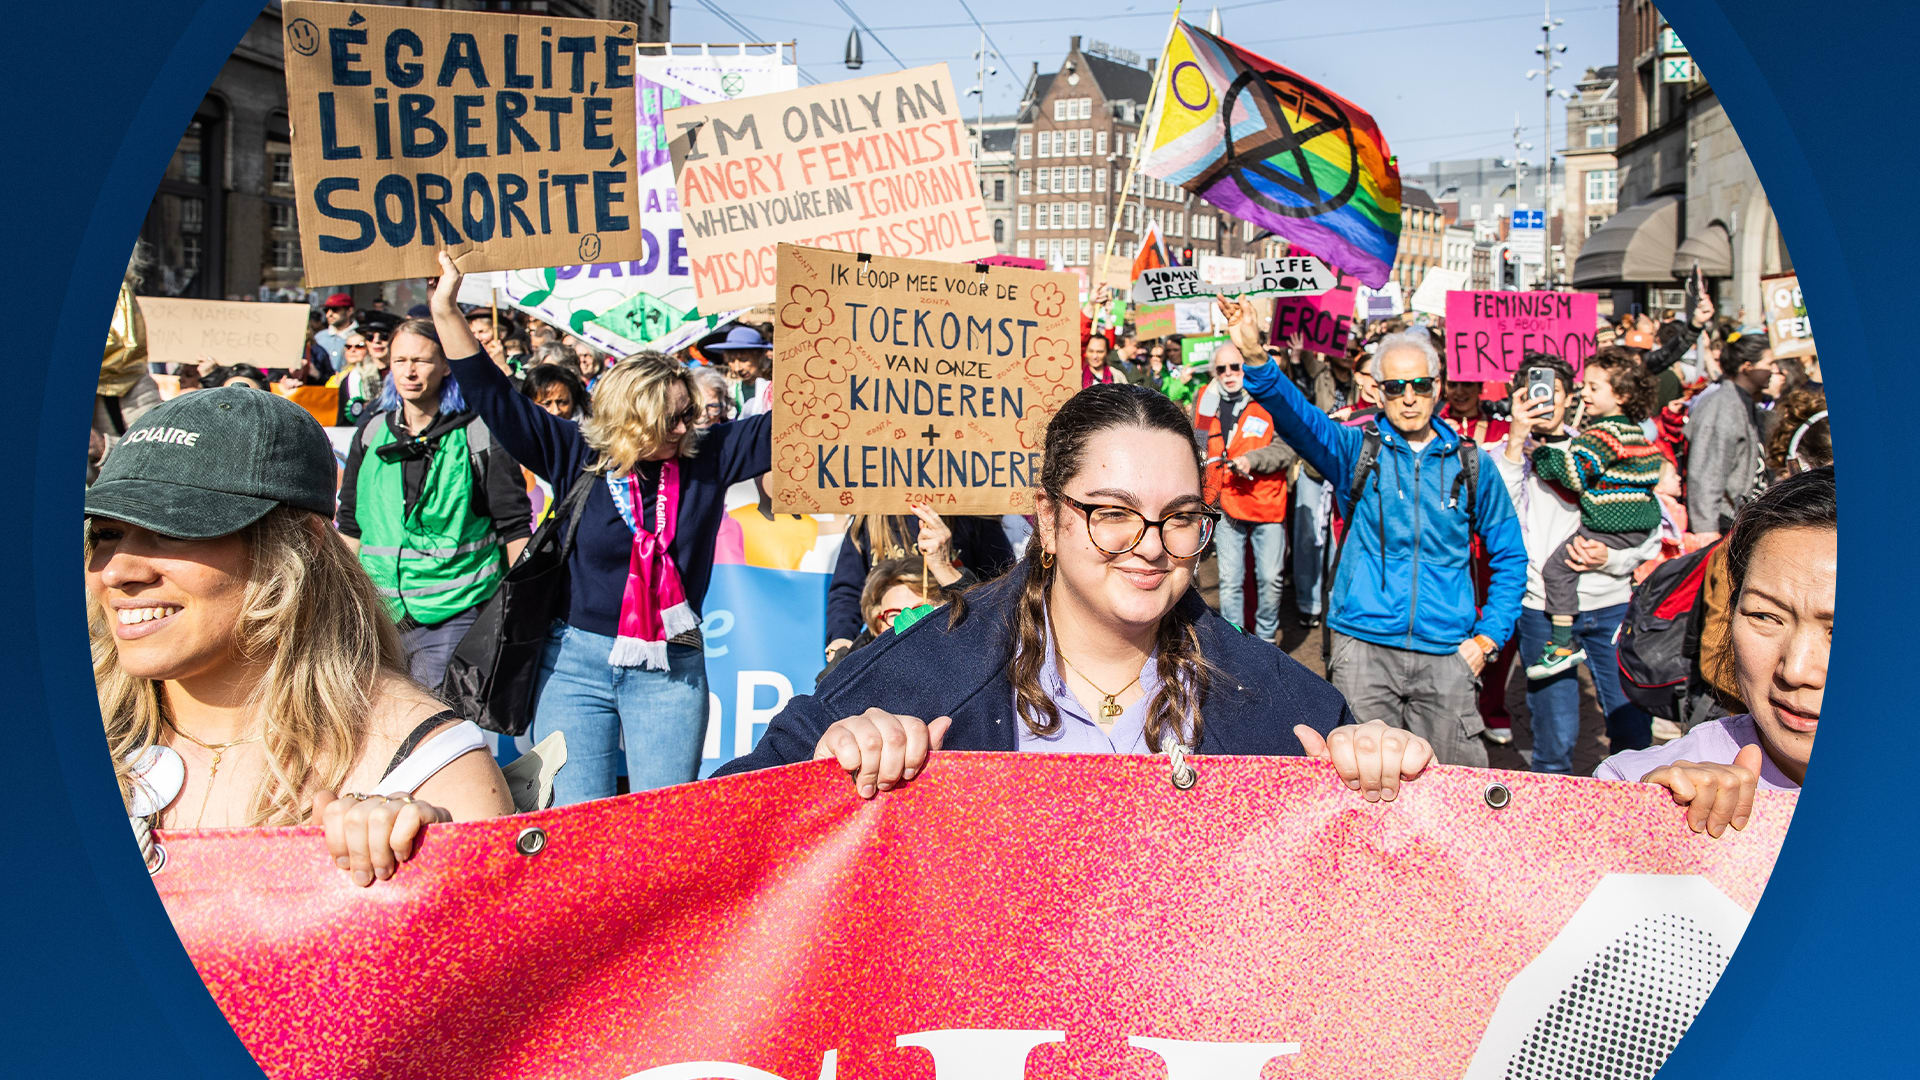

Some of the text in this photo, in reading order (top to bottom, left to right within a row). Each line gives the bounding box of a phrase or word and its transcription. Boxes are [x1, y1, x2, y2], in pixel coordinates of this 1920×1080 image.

[676, 113, 764, 161] I'M
[782, 89, 884, 143] ONLY
[896, 79, 948, 124] AN
[684, 119, 962, 207] ANGRY FEMINIST
[686, 203, 759, 239] WHEN
[822, 185, 854, 215] AN
[850, 160, 981, 221] IGNORANT
[877, 205, 991, 259] ASSHOLE
[830, 263, 1019, 301] IK LOOP MEE VOOR DE
[1144, 269, 1199, 286] WOMAN
[1260, 258, 1313, 275] LIFE
[919, 296, 950, 307] ZONTA
[1151, 281, 1199, 301] FREE
[190, 305, 263, 323] NAMENS
[1474, 293, 1572, 319] FEMINISM
[845, 302, 1038, 359] TOEKOMST
[1277, 305, 1352, 351] ERCE
[1514, 317, 1556, 332] ABOUT
[779, 340, 814, 362] ZONTA
[884, 353, 993, 379] VAN ONZE
[849, 374, 1024, 419] KINDEREN
[123, 427, 201, 447] SOLAIRE
[905, 492, 957, 504] ZONTA
